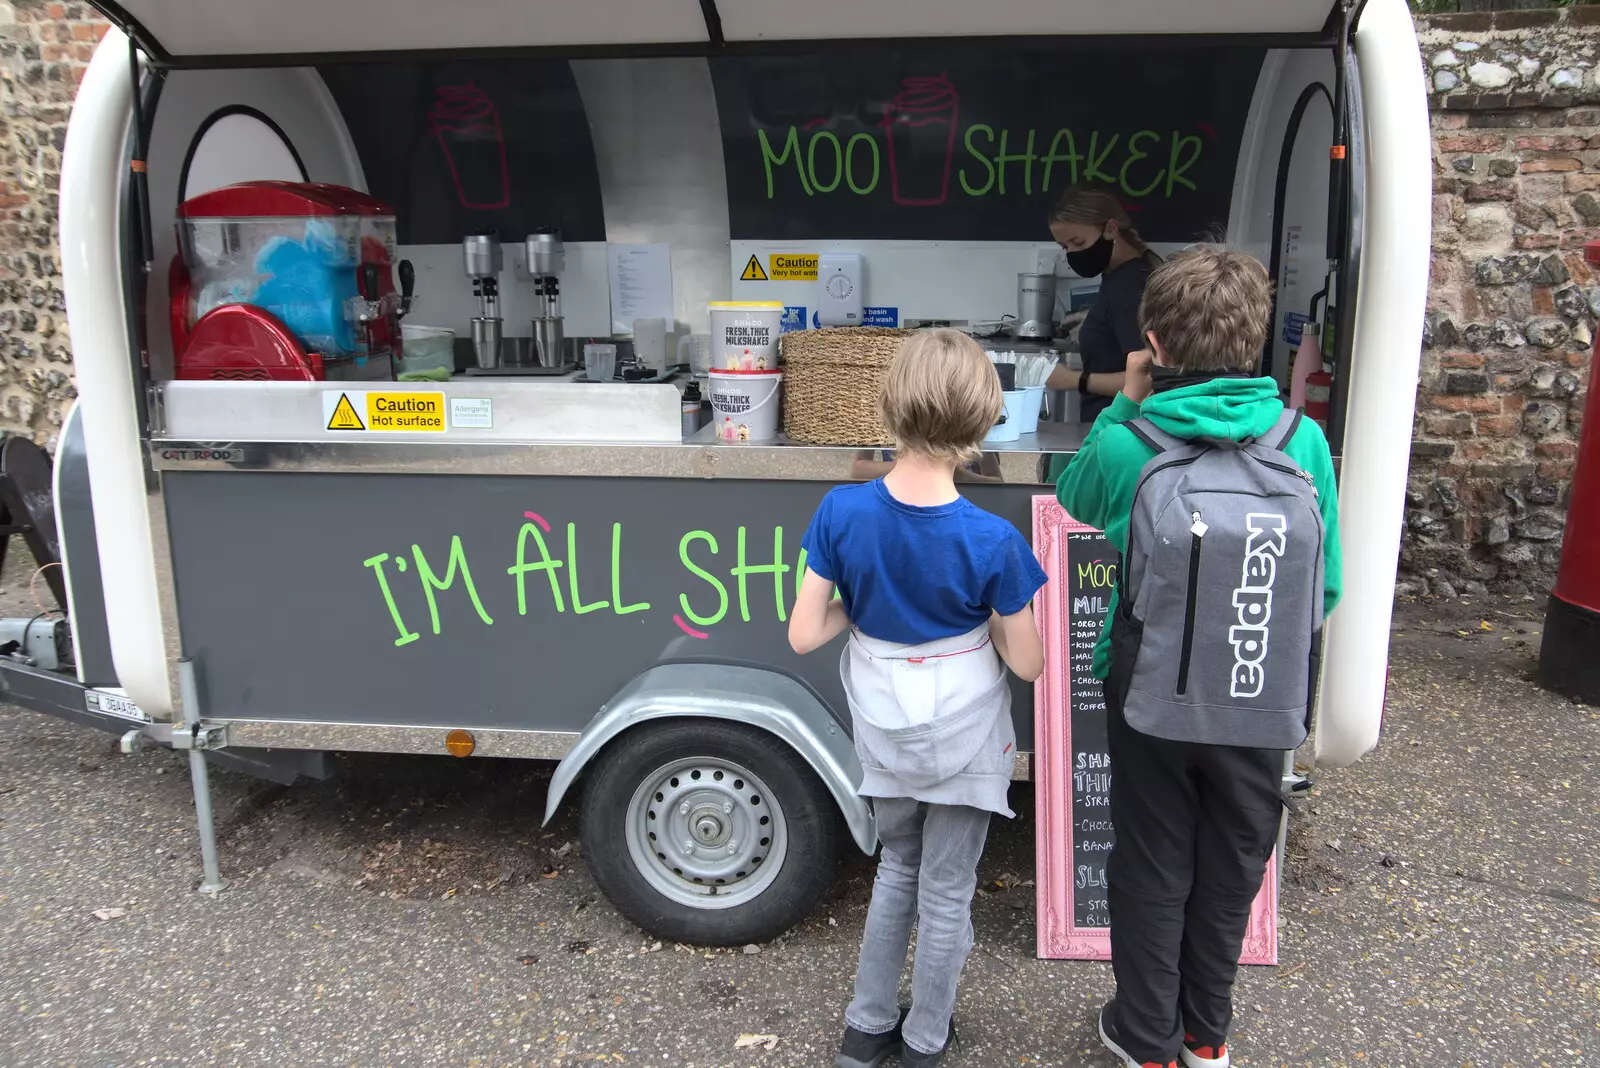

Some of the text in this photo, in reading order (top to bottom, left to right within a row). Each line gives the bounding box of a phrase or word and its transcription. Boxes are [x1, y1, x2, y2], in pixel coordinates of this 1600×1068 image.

[758, 124, 1202, 199] MOO SHAKER
[776, 257, 819, 267] Caution
[772, 269, 788, 277] Very
[725, 336, 769, 346] MILKSHAKES
[376, 397, 436, 412] Caution
[372, 415, 393, 427] Hot
[397, 414, 441, 427] surface
[363, 522, 809, 647] I'M ALL SH
[1073, 595, 1109, 615] MIL
[1228, 512, 1287, 698] Kappa
